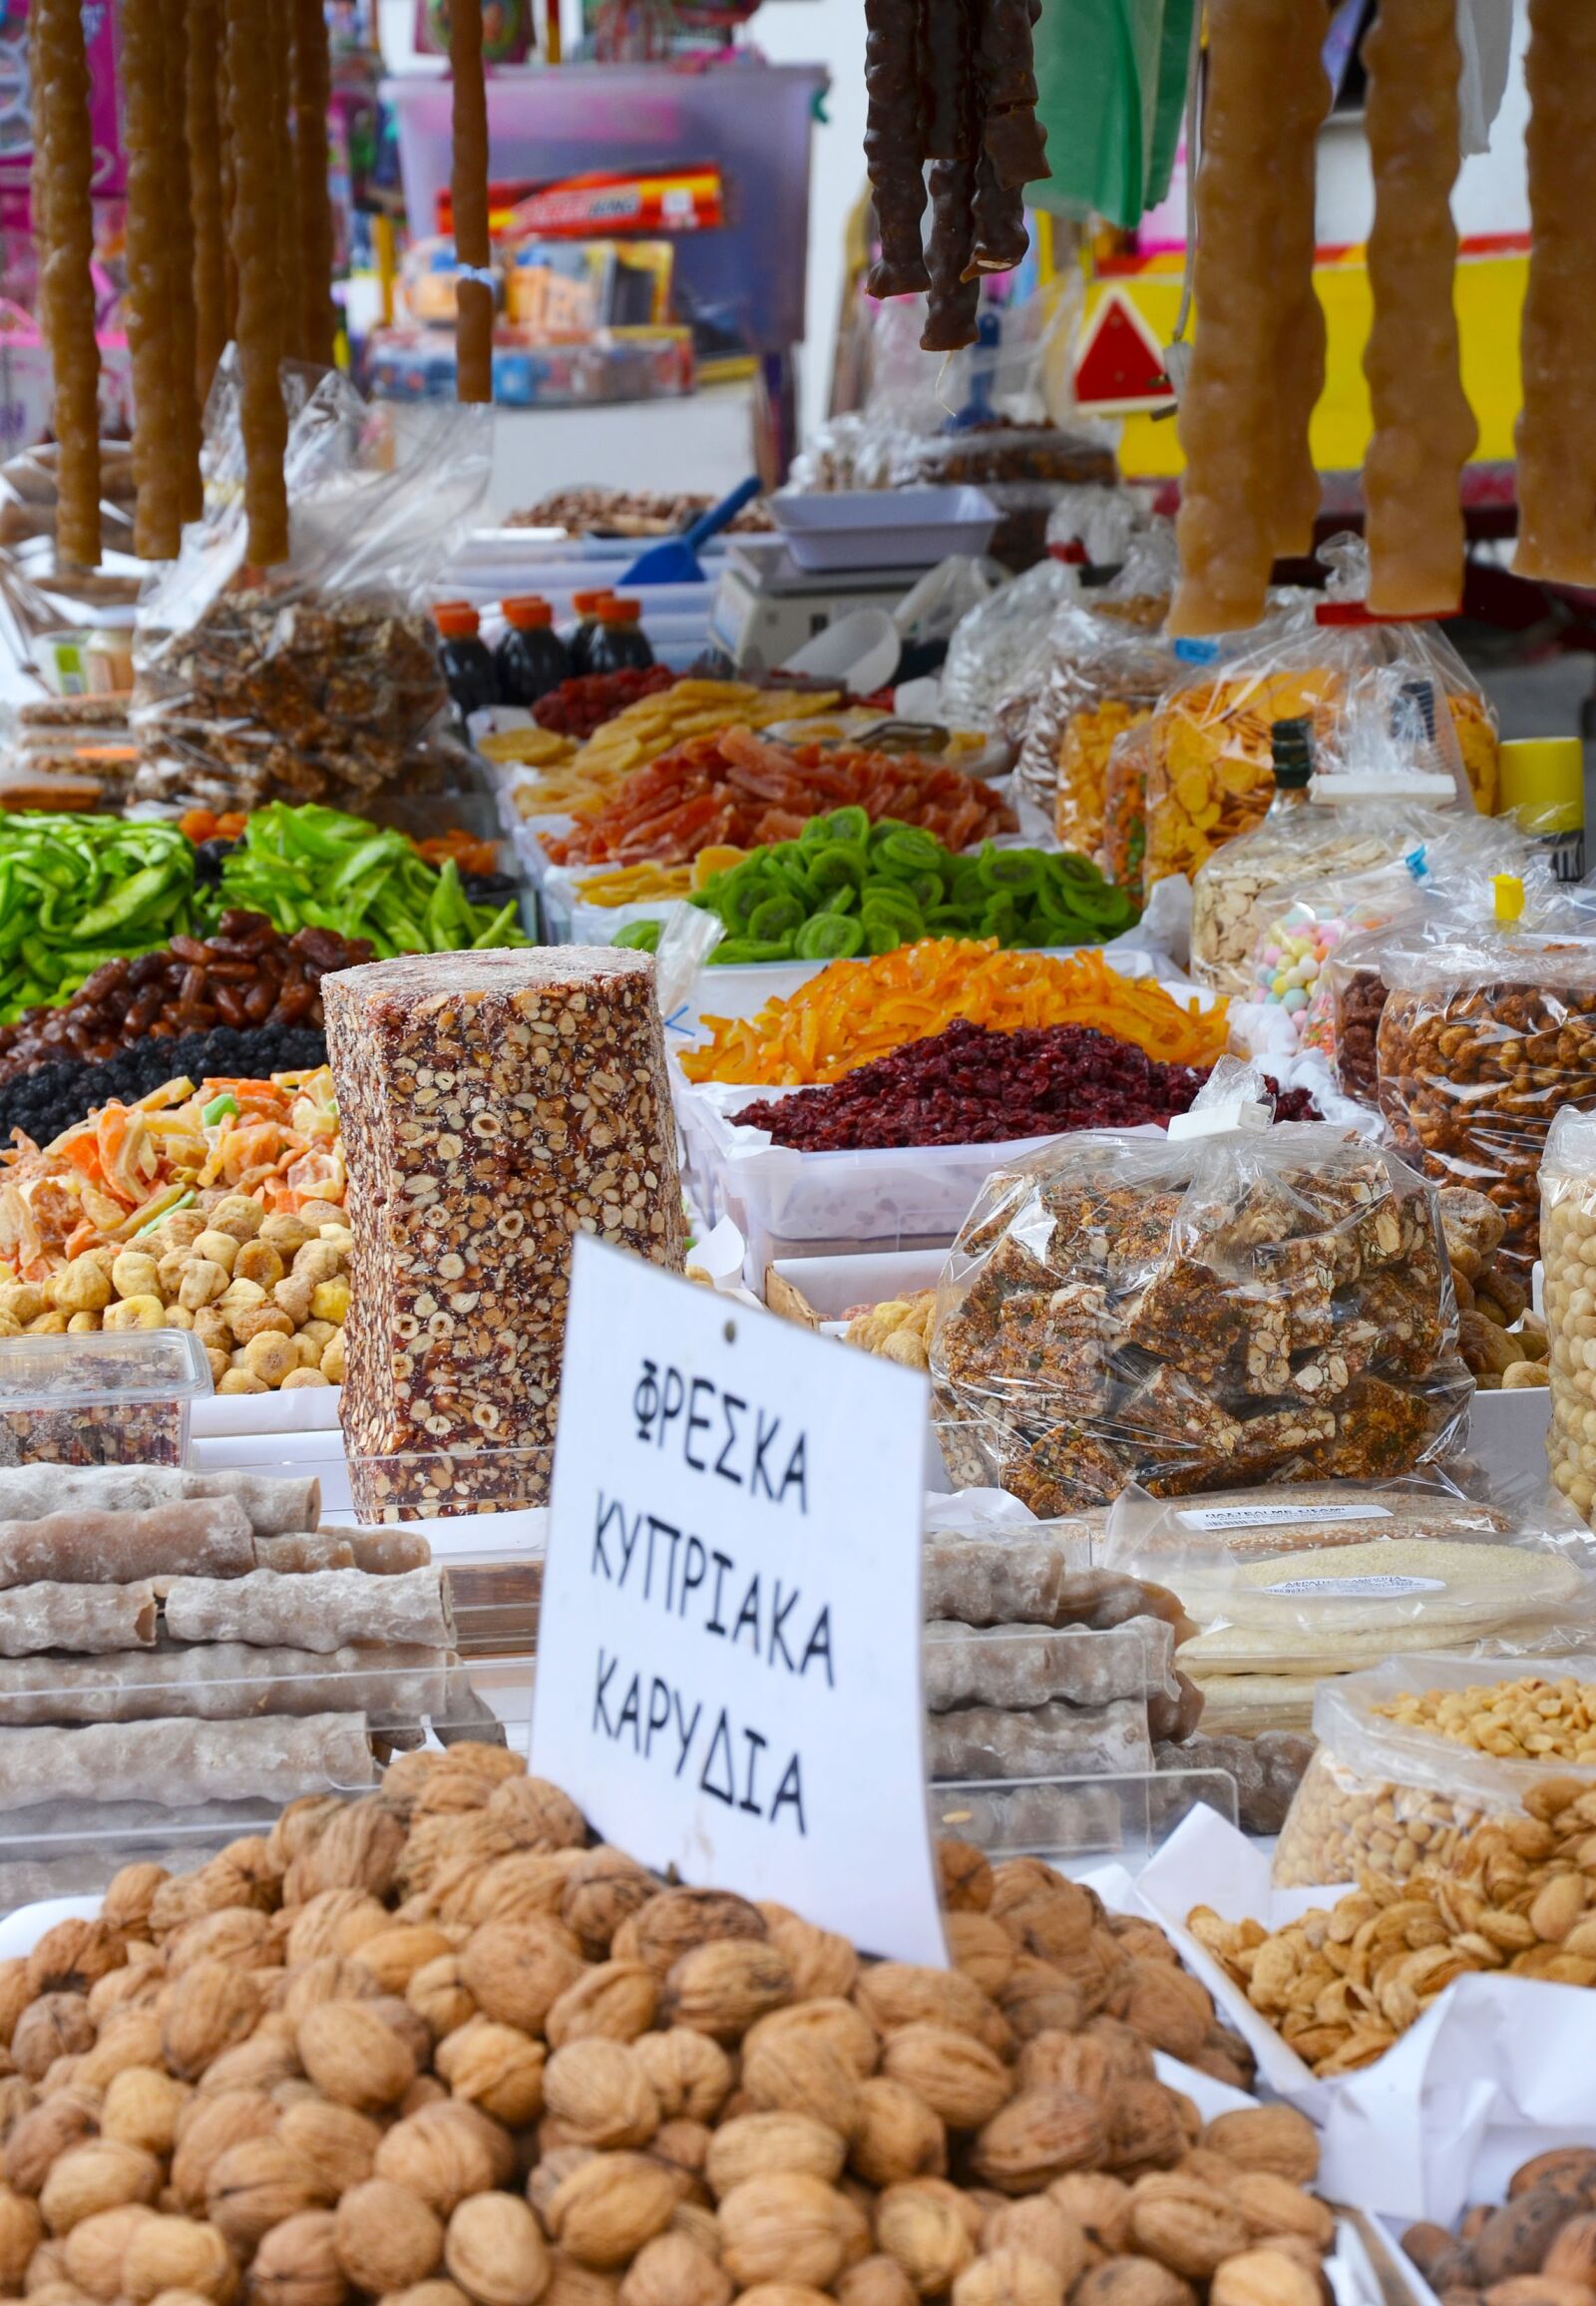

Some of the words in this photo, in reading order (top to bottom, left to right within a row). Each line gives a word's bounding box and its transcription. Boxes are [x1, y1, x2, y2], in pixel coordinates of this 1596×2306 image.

[633, 1358, 810, 1515] ΦΡΕΣΚΑ
[592, 1490, 836, 1690] ΚΥΠΡΙΑΚΑ
[593, 1648, 810, 1837] ΚΑΡΥΔΙΑ
